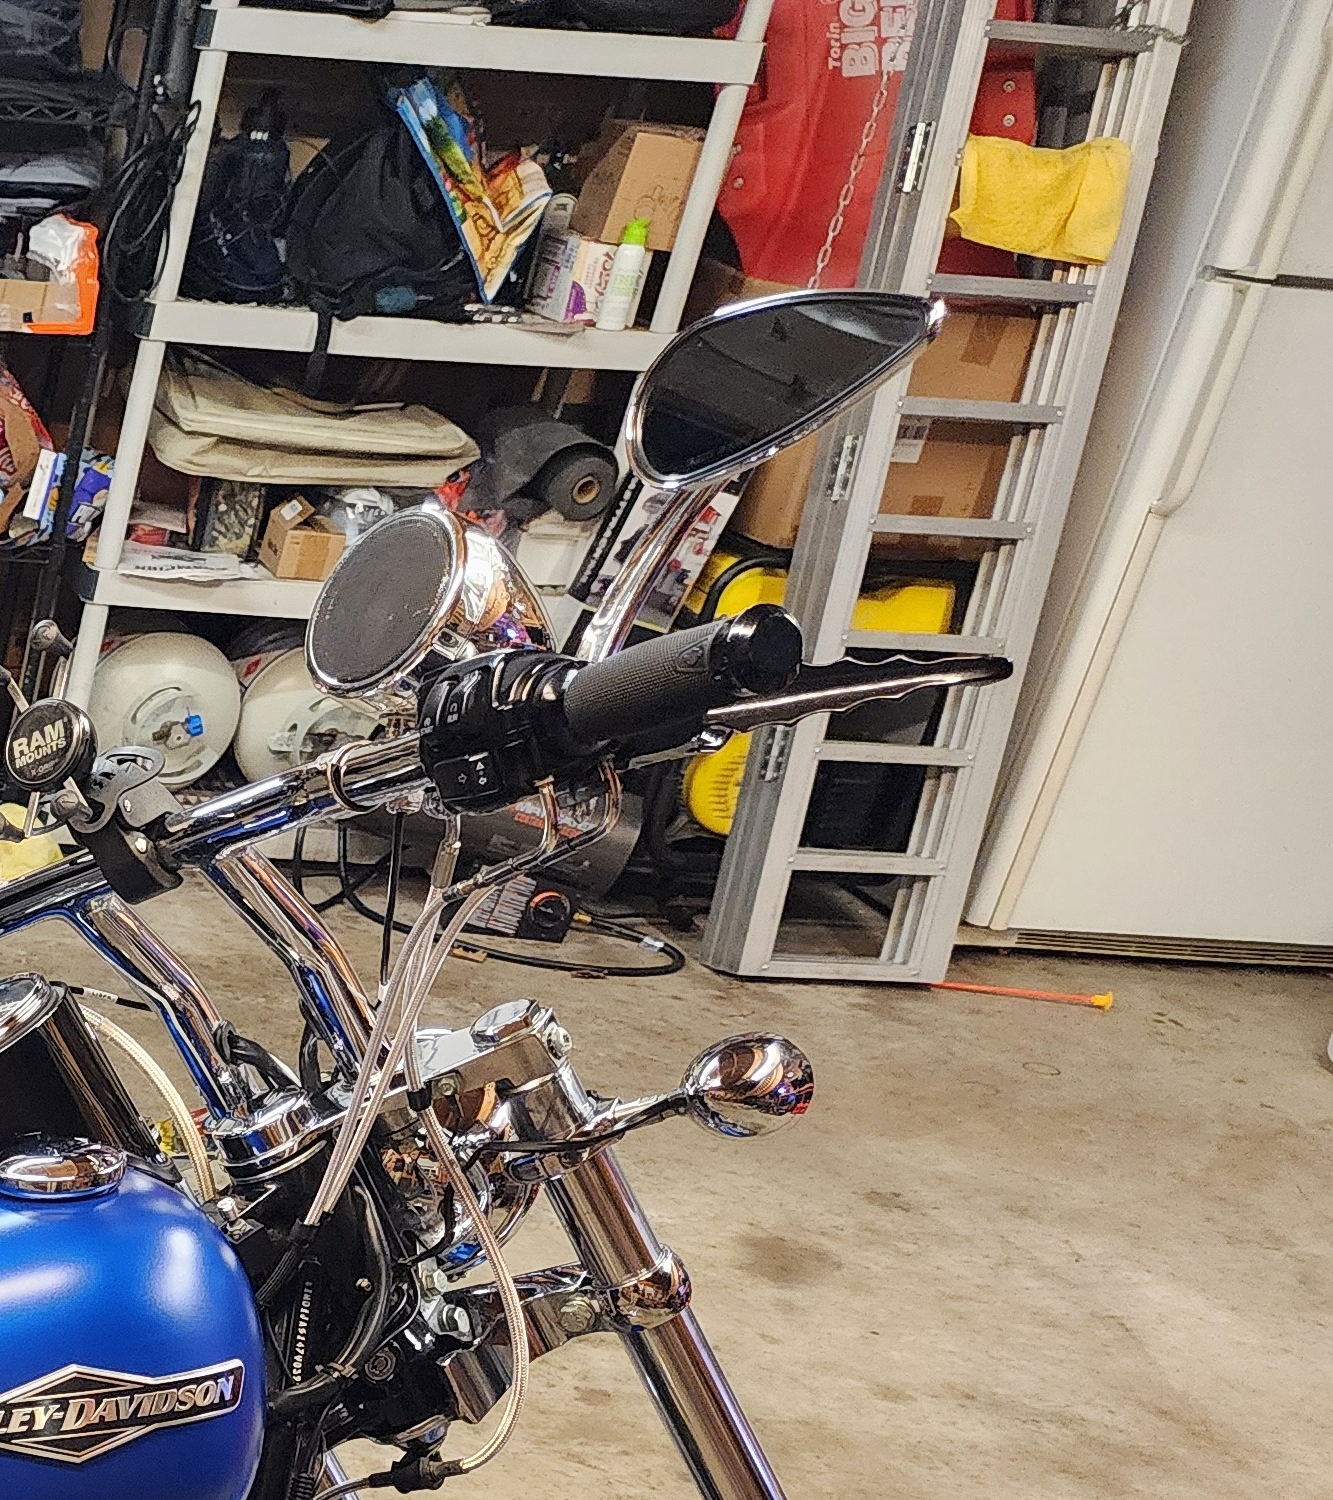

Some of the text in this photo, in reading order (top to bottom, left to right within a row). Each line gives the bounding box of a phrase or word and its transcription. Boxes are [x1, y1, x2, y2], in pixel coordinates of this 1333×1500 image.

[825, 22, 841, 70] Torin
[839, 0, 880, 77] BIG
[880, 0, 918, 72] RE
[13, 719, 65, 759] RAM
[15, 737, 66, 769] MOUNTS
